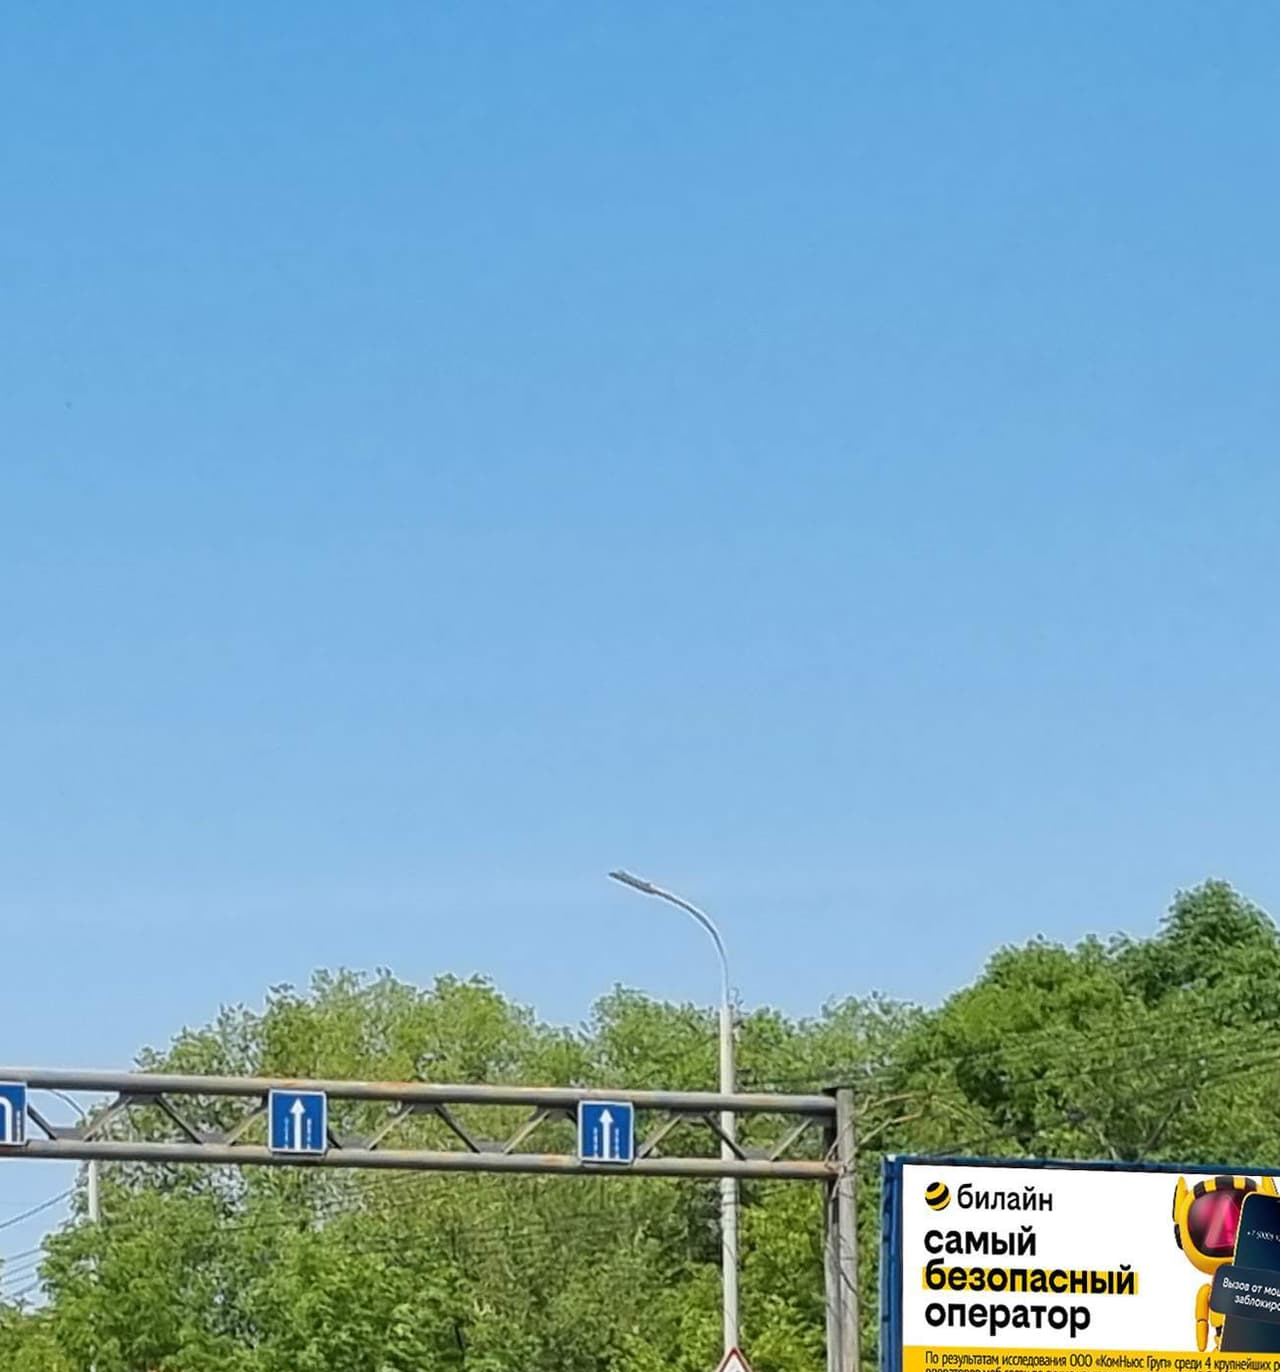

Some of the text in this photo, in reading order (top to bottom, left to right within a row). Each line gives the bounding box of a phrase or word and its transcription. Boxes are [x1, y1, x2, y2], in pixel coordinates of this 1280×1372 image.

[957, 1183, 1053, 1211] билайн
[924, 1225, 1036, 1256] самый
[925, 1257, 1135, 1295] безопасный
[1222, 1277, 1250, 1291] Вызов
[1251, 1284, 1263, 1293] от
[925, 1302, 1091, 1338] оператор
[925, 1351, 939, 1364] По
[942, 1354, 999, 1367] результатам
[1002, 1355, 1067, 1368] исследования
[1070, 1353, 1093, 1367] ООО
[1174, 1358, 1202, 1371] среди
[1205, 1357, 1211, 1369] 4
[1214, 1358, 1271, 1372] крупнейших
